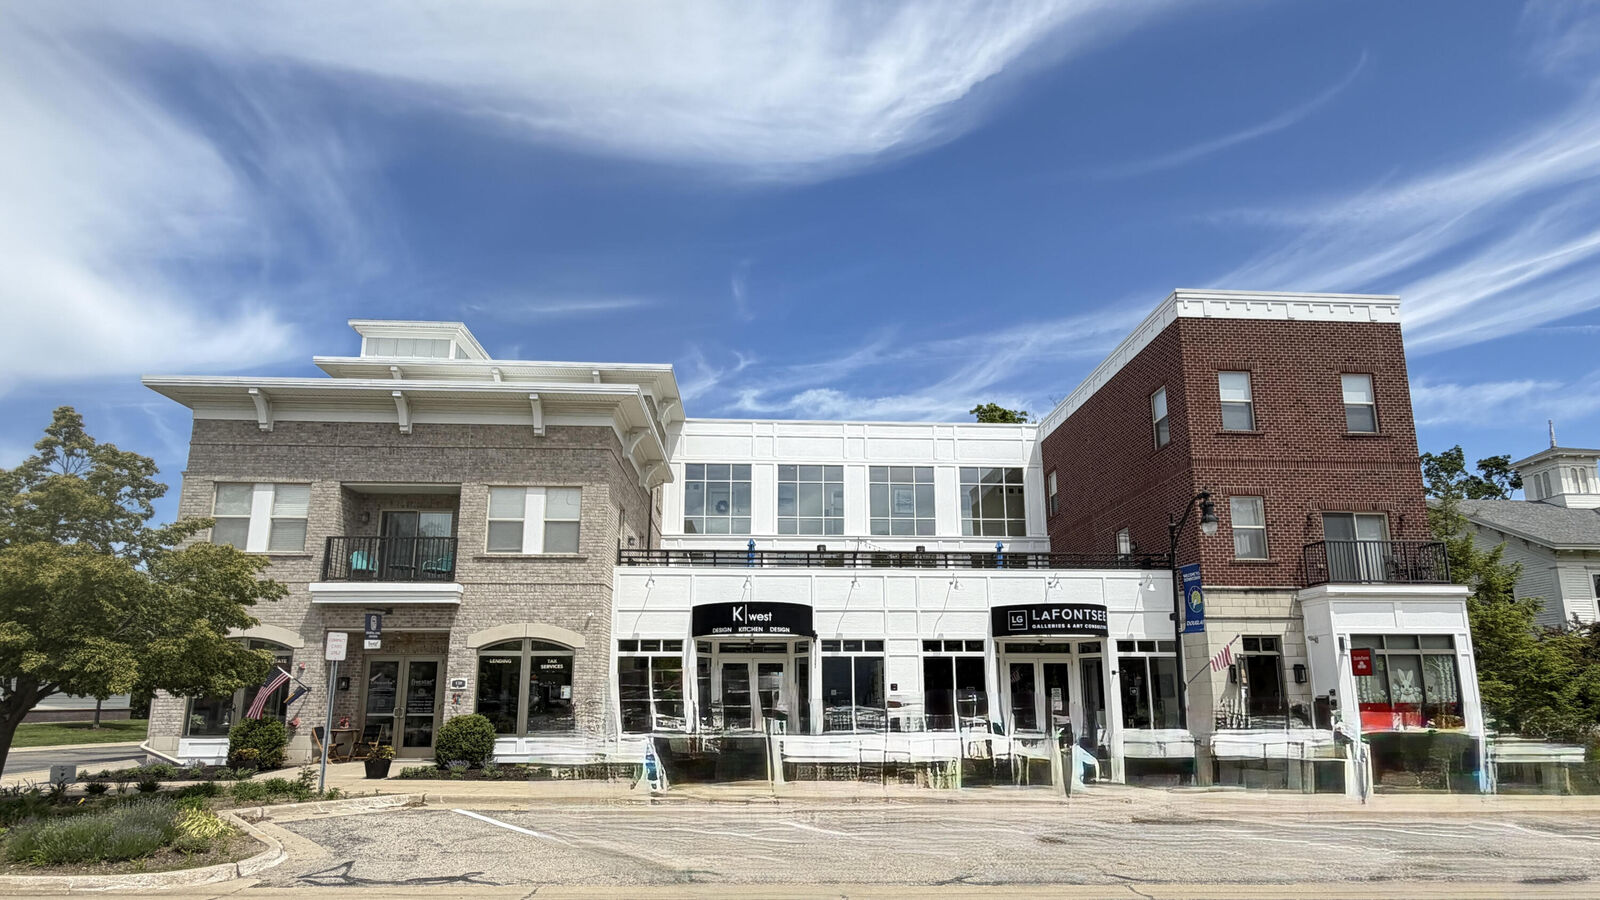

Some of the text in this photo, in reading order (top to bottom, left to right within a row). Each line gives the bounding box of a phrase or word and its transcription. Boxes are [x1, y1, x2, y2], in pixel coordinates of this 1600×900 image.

[748, 611, 773, 622] west
[1011, 615, 1024, 623] LG
[1032, 608, 1107, 622] LAFONTSEE
